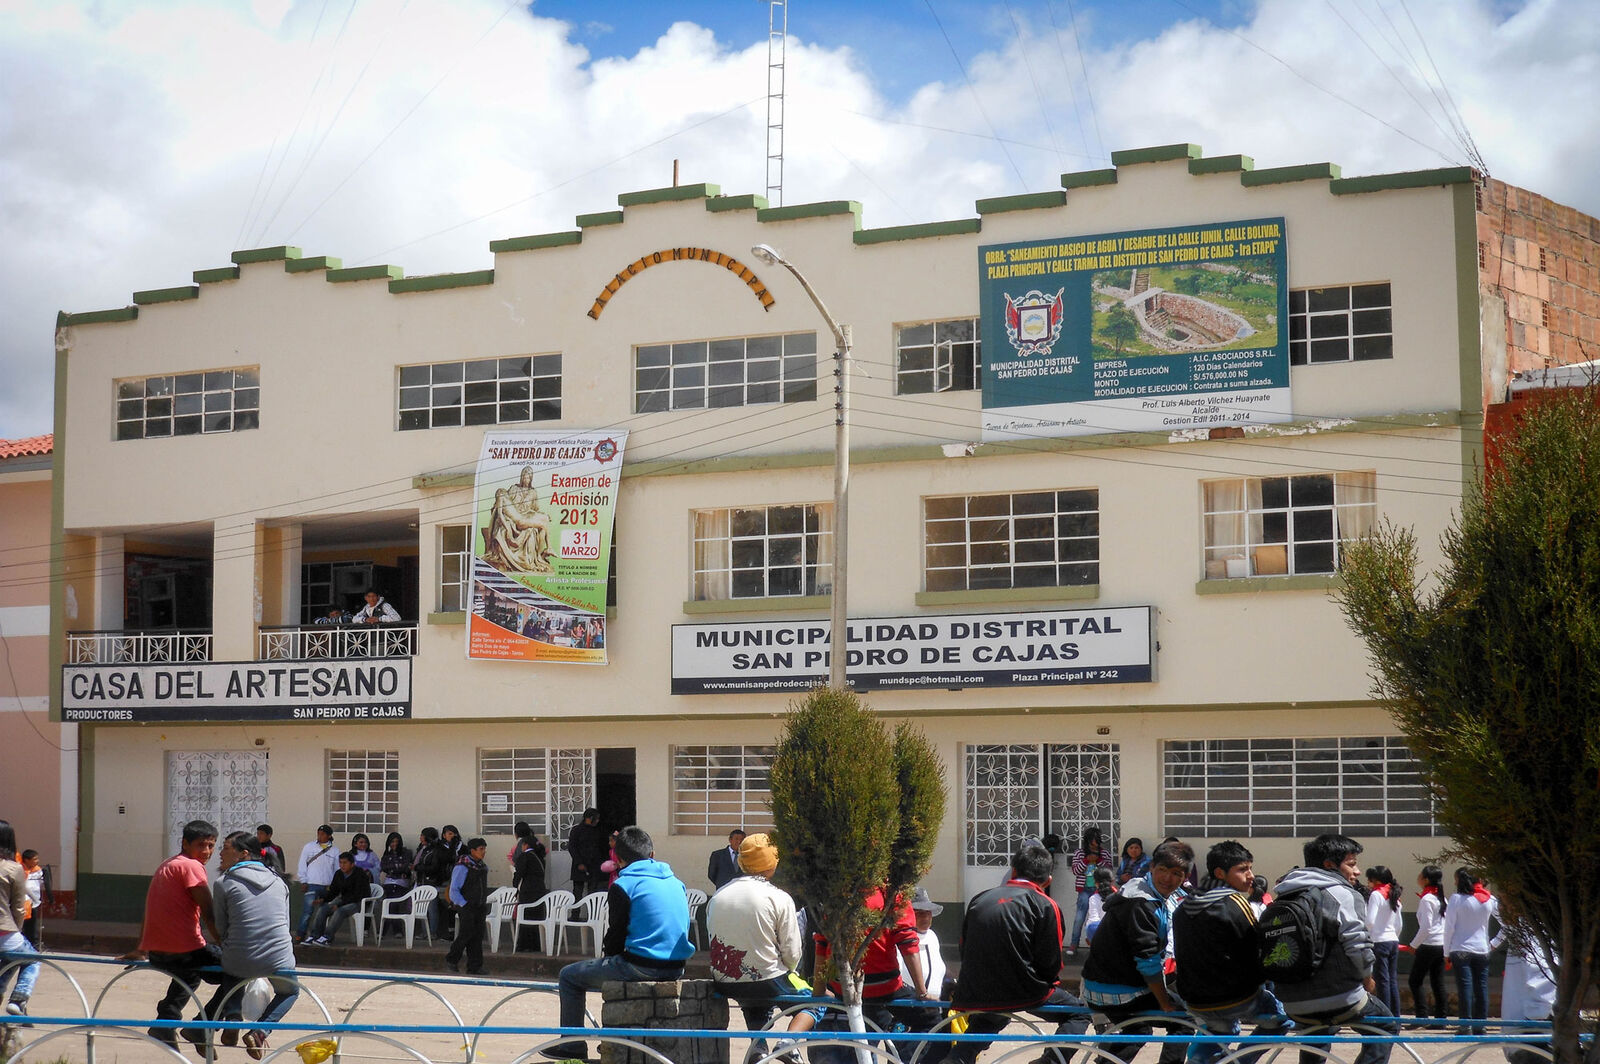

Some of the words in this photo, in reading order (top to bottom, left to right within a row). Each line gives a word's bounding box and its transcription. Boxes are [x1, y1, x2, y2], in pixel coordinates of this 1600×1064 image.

[986, 250, 1006, 264] OBRA:
[1060, 242, 1085, 257] BASICO
[1087, 241, 1096, 254] DE
[1097, 239, 1117, 253] AGUA
[1118, 238, 1123, 251] Y
[1124, 235, 1156, 251] DESAGUE
[1158, 234, 1167, 247] DE
[1168, 234, 1176, 246] LA
[1178, 232, 1199, 246] CALLE
[1224, 227, 1246, 241] CALLE
[1247, 224, 1280, 239] BOLIVAR,
[988, 265, 1009, 279] PLAZA
[1010, 262, 1046, 277] PRINCIPAL
[1046, 261, 1052, 273] Y
[1052, 259, 1072, 273] CALLE
[1073, 257, 1098, 270] TARMA
[1100, 255, 1112, 268] DEL
[1113, 252, 1146, 267] DISTRITO
[1148, 251, 1157, 264] DE
[1159, 250, 1173, 263] SAN
[1174, 247, 1198, 262] PEDRO
[1200, 247, 1209, 260] DE
[1211, 244, 1234, 258] CAJAS
[587, 252, 662, 320] PALACIO
[672, 247, 776, 312] MUNICIPAL
[990, 358, 1044, 371] MUNICIPALIDAD
[1045, 356, 1080, 367] DISTRITAL
[1094, 361, 1127, 370] EMPRESA
[1212, 351, 1254, 361] ASOCIADOS
[1256, 350, 1276, 358] S.R.L.
[998, 370, 1012, 379] SAN
[1013, 368, 1035, 378] PEDRO
[1037, 368, 1048, 377] DE
[1049, 365, 1073, 375] CAJAS
[1094, 370, 1117, 378] PLAZO
[1223, 360, 1263, 369] Calendarios
[1094, 379, 1119, 388] MONTO
[1094, 386, 1135, 396] MODALIDAD
[1148, 383, 1188, 393] EJECUCION
[1193, 382, 1222, 390] Contrata
[1250, 378, 1273, 386] alzada.
[1142, 401, 1159, 409] Prof.
[1161, 399, 1177, 407] Luis
[1178, 398, 1205, 407] Alberto
[1208, 397, 1233, 405] Vilchez
[1235, 394, 1270, 404] Huaynate
[1163, 417, 1191, 425] Gestion
[1210, 414, 1226, 422] 2011
[512, 447, 542, 459] PEDRO
[544, 447, 556, 459] DE
[558, 447, 591, 459] CAJAS"
[551, 474, 595, 488] Examen
[598, 474, 611, 488] de
[550, 490, 609, 506] Admisión
[559, 509, 598, 525] 2013
[573, 532, 588, 544] 31
[561, 546, 598, 556] MARZO
[951, 617, 1122, 639] DISTRITAL
[732, 652, 793, 670] SAN
[805, 648, 908, 667] PDRO
[920, 647, 961, 664] DE
[972, 643, 1080, 663] CAJAS
[71, 672, 144, 700] CASA
[155, 671, 214, 699] DEL
[225, 666, 398, 698] ARTESANO
[1012, 674, 1038, 682] Plaza
[1041, 671, 1083, 682] Principal
[1100, 670, 1118, 678] 242
[66, 710, 133, 720] PRODUCTORES
[293, 708, 313, 718] SAN
[316, 708, 351, 718] PEDRO
[354, 707, 369, 717] DE
[372, 706, 404, 717] CAJAS
